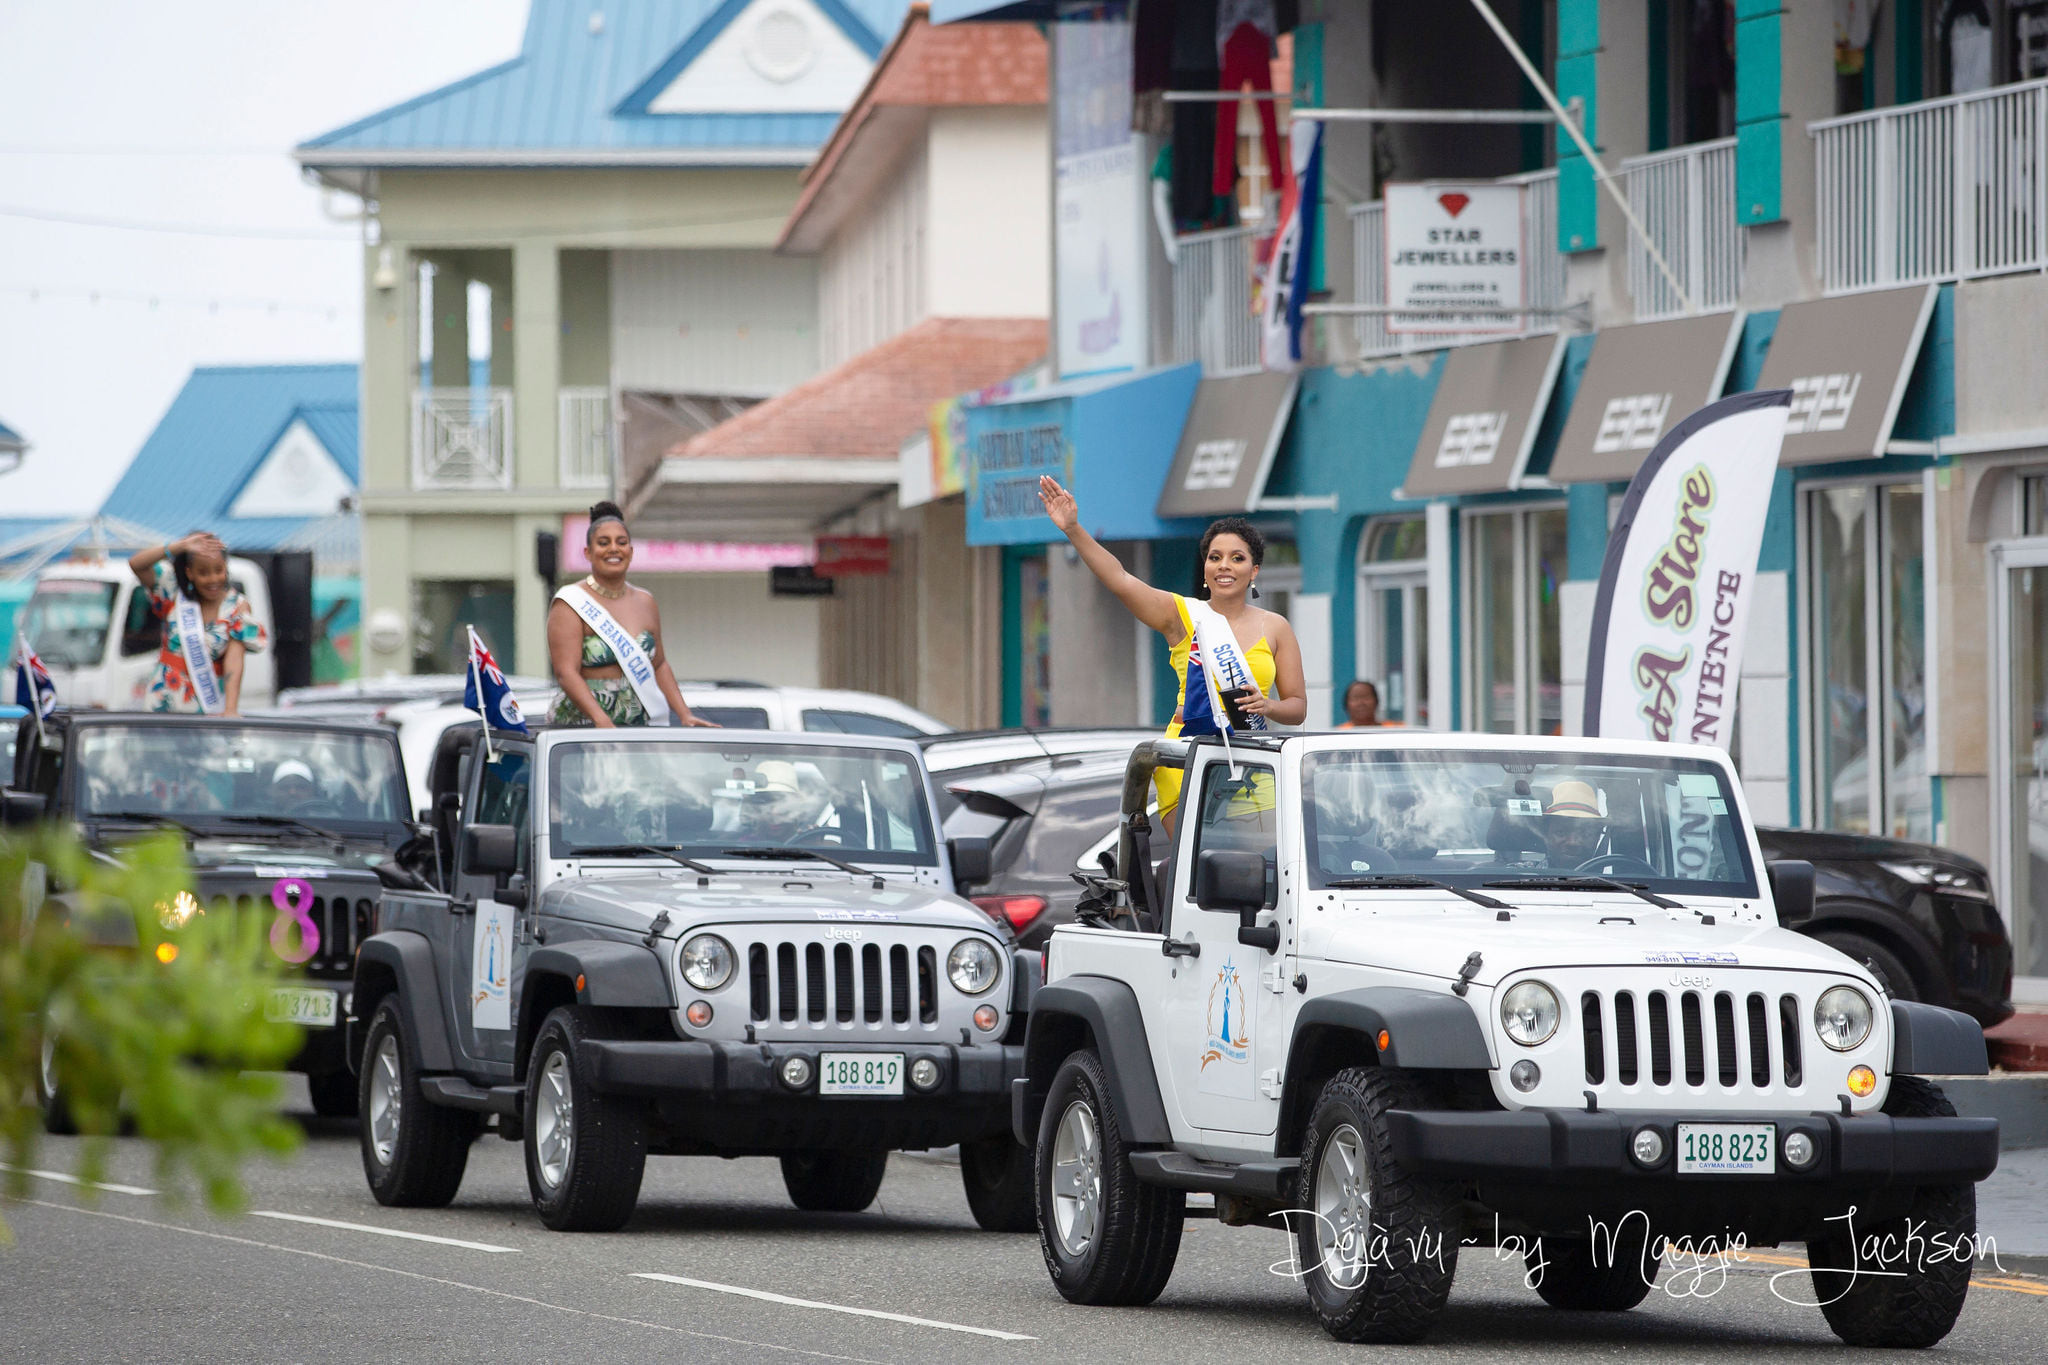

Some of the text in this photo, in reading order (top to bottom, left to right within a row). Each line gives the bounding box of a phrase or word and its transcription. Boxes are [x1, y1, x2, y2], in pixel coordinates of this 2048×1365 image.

[1427, 228, 1482, 244] STAR
[1392, 251, 1517, 266] JEWELLERS
[1647, 469, 1711, 627] Store
[580, 600, 652, 687] THE EBANKS CLAN
[1690, 569, 1741, 742] NIENCE
[824, 926, 863, 943] Jeep
[1668, 971, 1714, 990] Jeep
[826, 1061, 897, 1084] 188 819
[1684, 1133, 1768, 1162] 188 823
